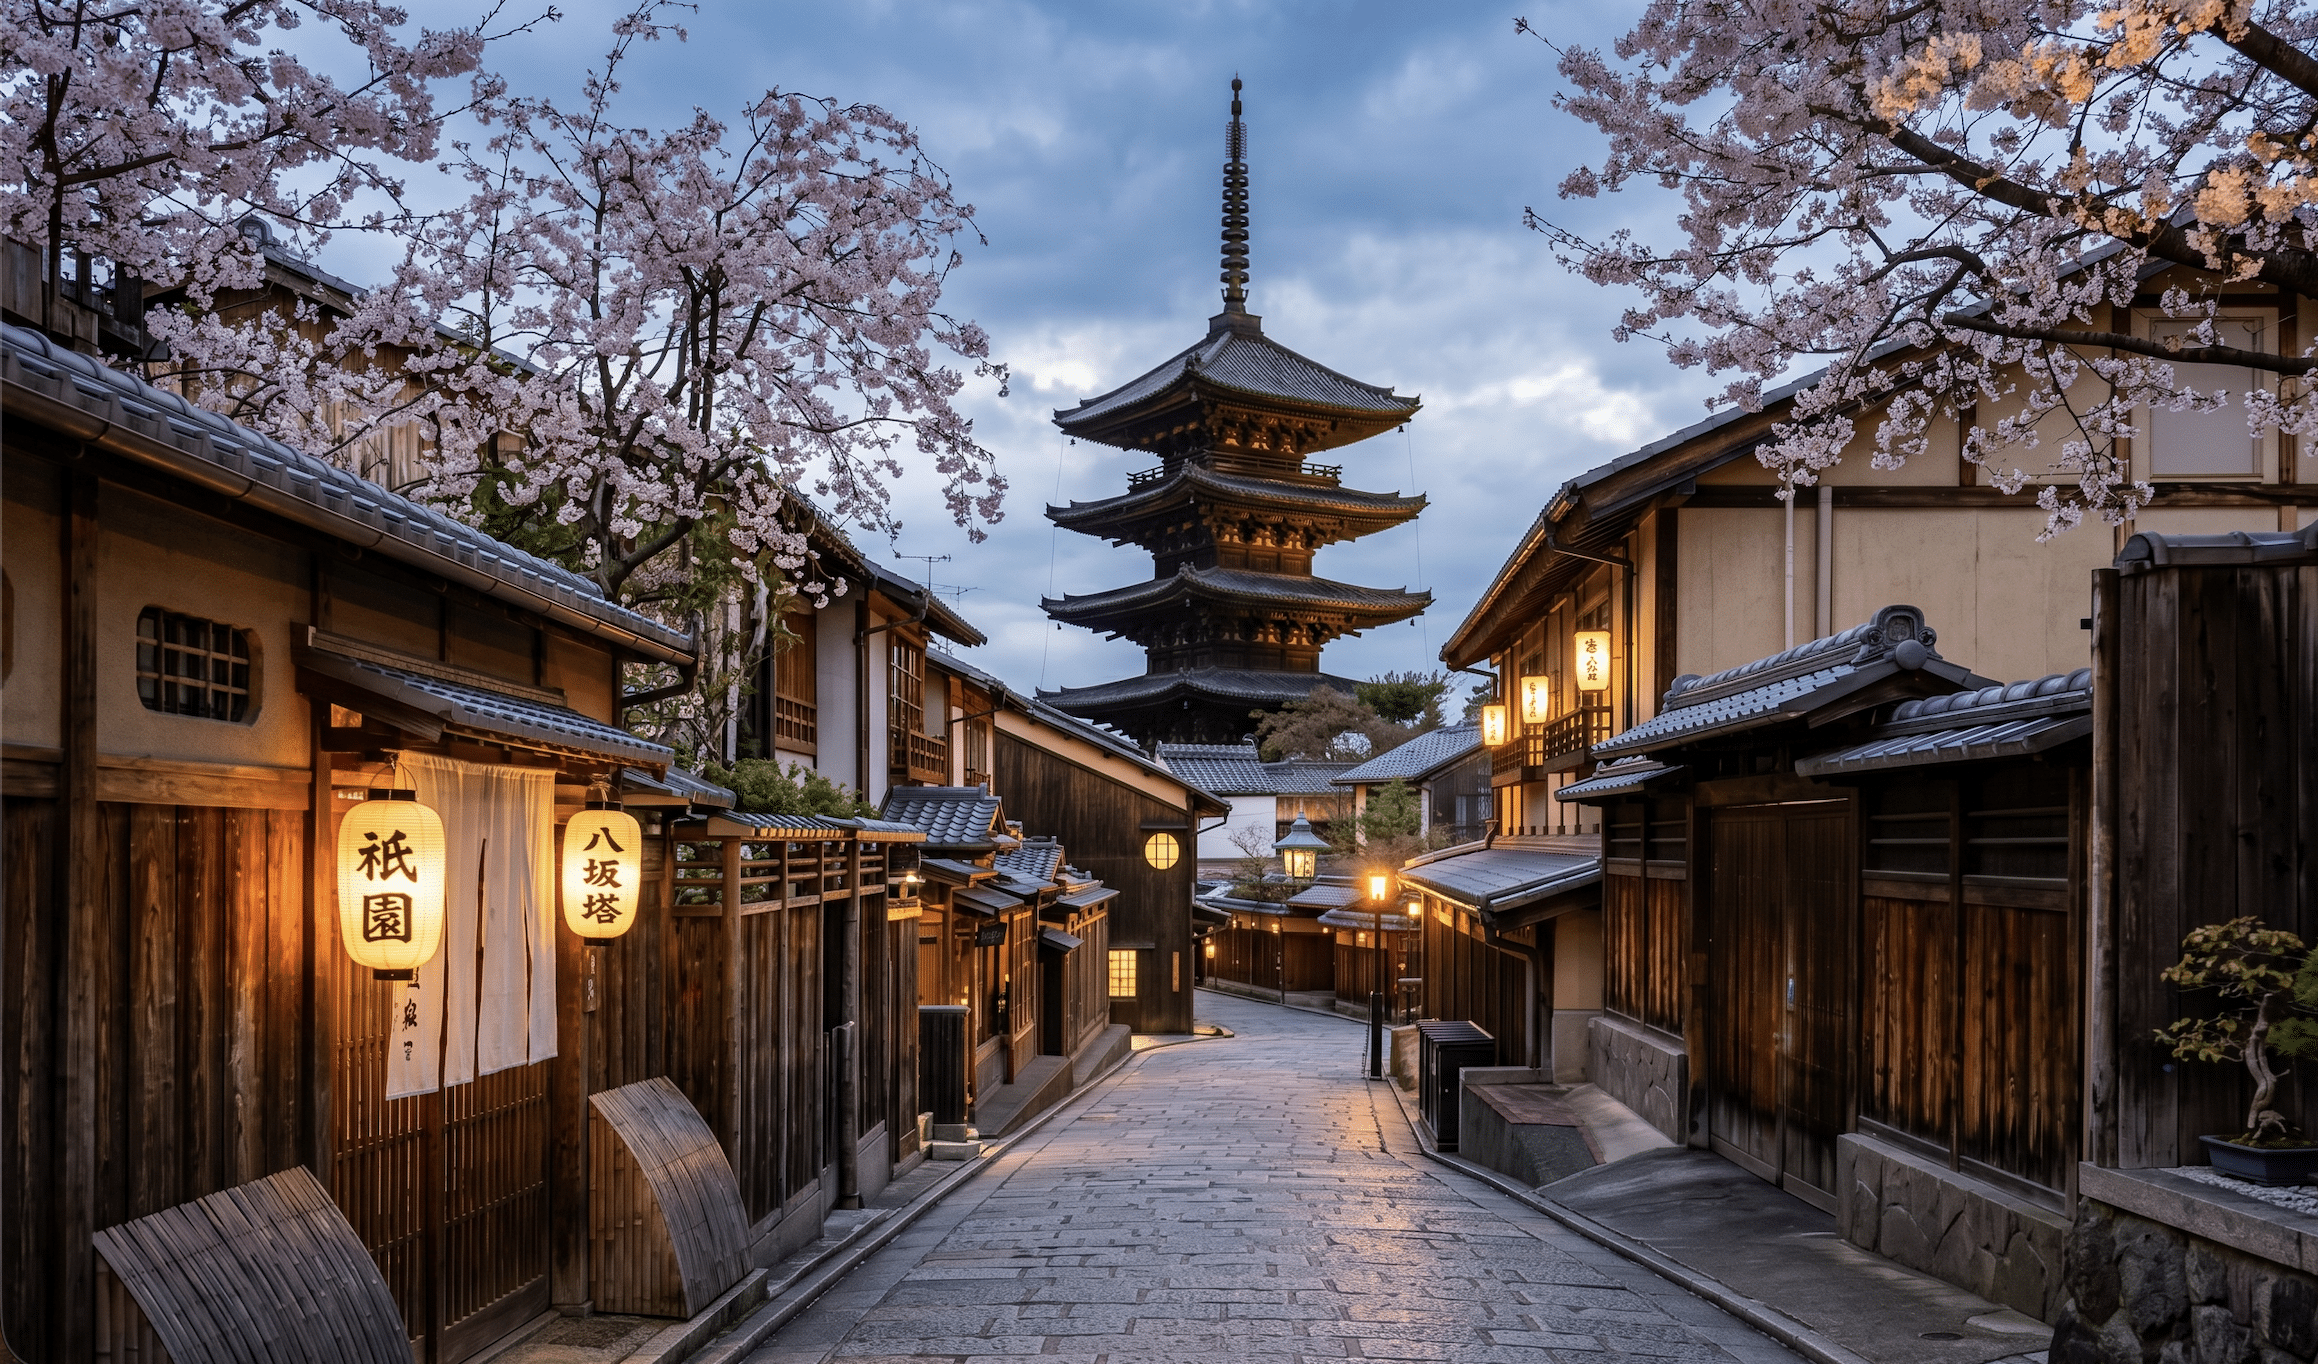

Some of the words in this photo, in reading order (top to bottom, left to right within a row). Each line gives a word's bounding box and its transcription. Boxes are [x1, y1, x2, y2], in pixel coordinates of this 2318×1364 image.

[356, 829, 417, 944] 祇園
[581, 827, 625, 924] 八坂塔
